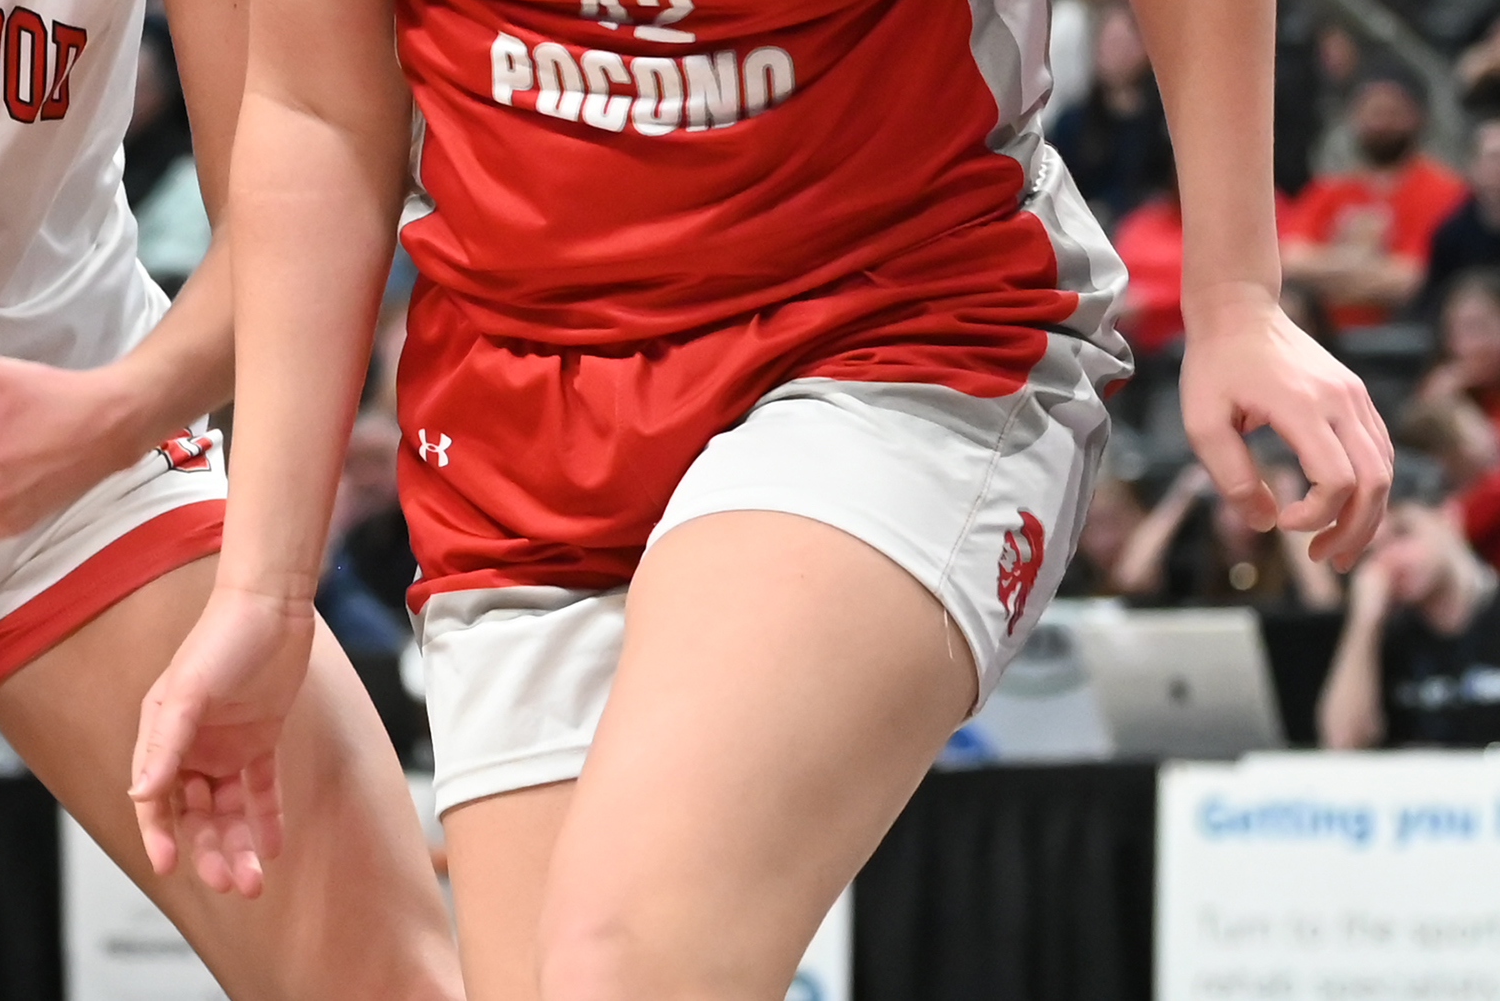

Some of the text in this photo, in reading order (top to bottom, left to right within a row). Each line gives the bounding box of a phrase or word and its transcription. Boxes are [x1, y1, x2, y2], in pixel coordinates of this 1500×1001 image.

[491, 30, 796, 137] POCONO
[1197, 795, 1373, 850] Getting
[1393, 806, 1477, 851] you
